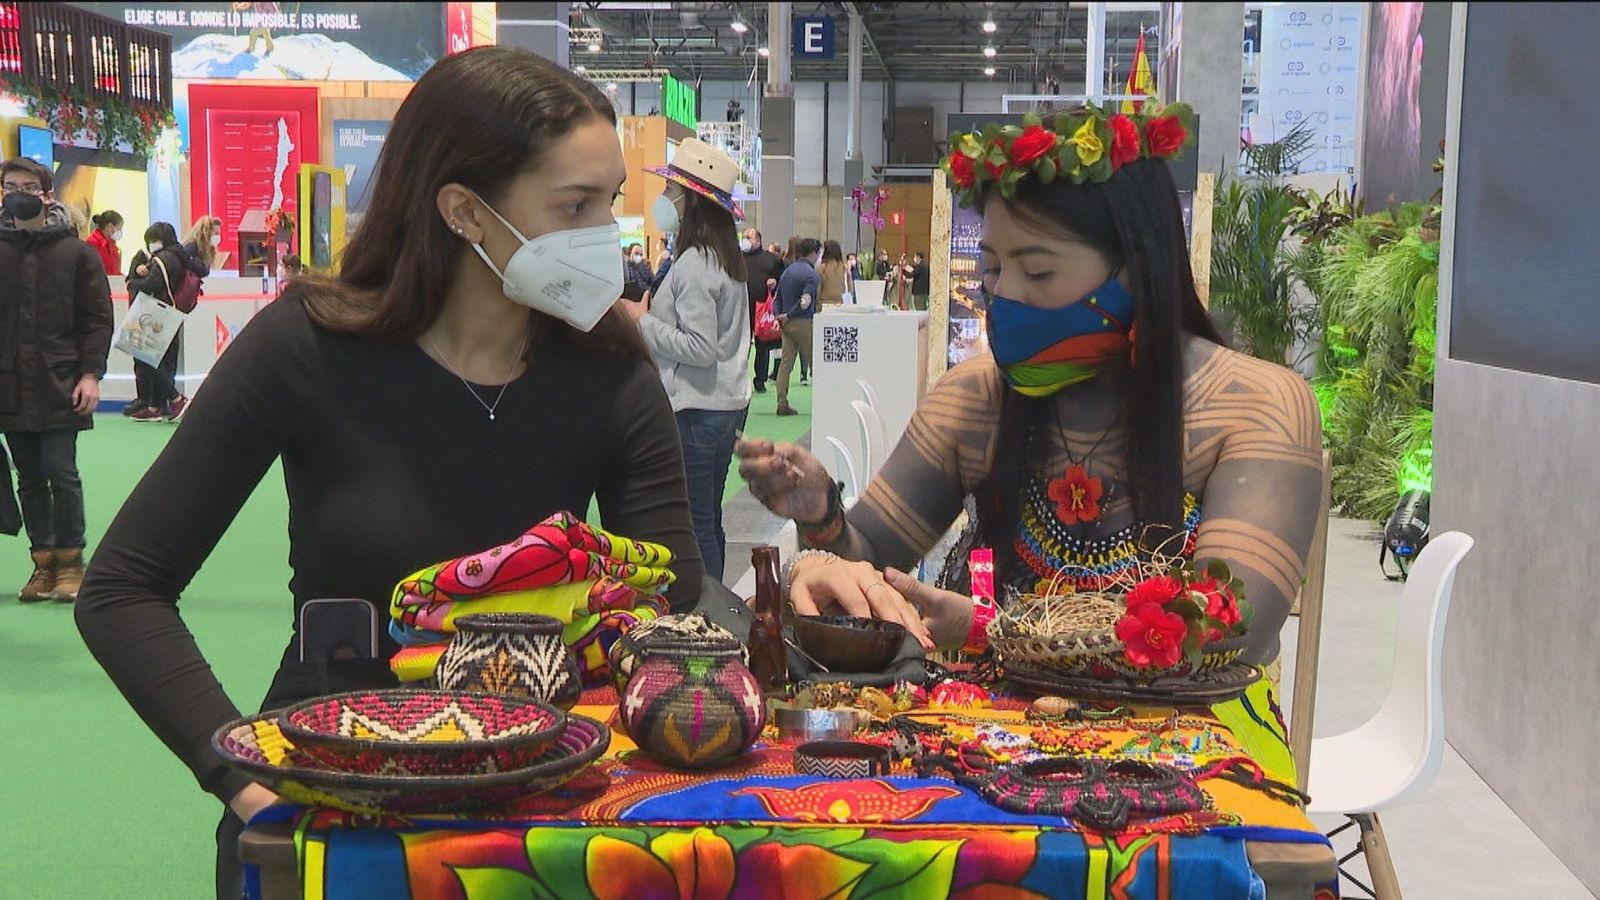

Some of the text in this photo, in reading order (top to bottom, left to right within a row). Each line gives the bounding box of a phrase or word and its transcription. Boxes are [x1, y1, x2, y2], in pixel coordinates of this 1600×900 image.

[125, 8, 361, 29] ELIGE CHILE. DONDE LO IMPOSIBLE, ES POSIBLE.
[805, 22, 823, 52] E
